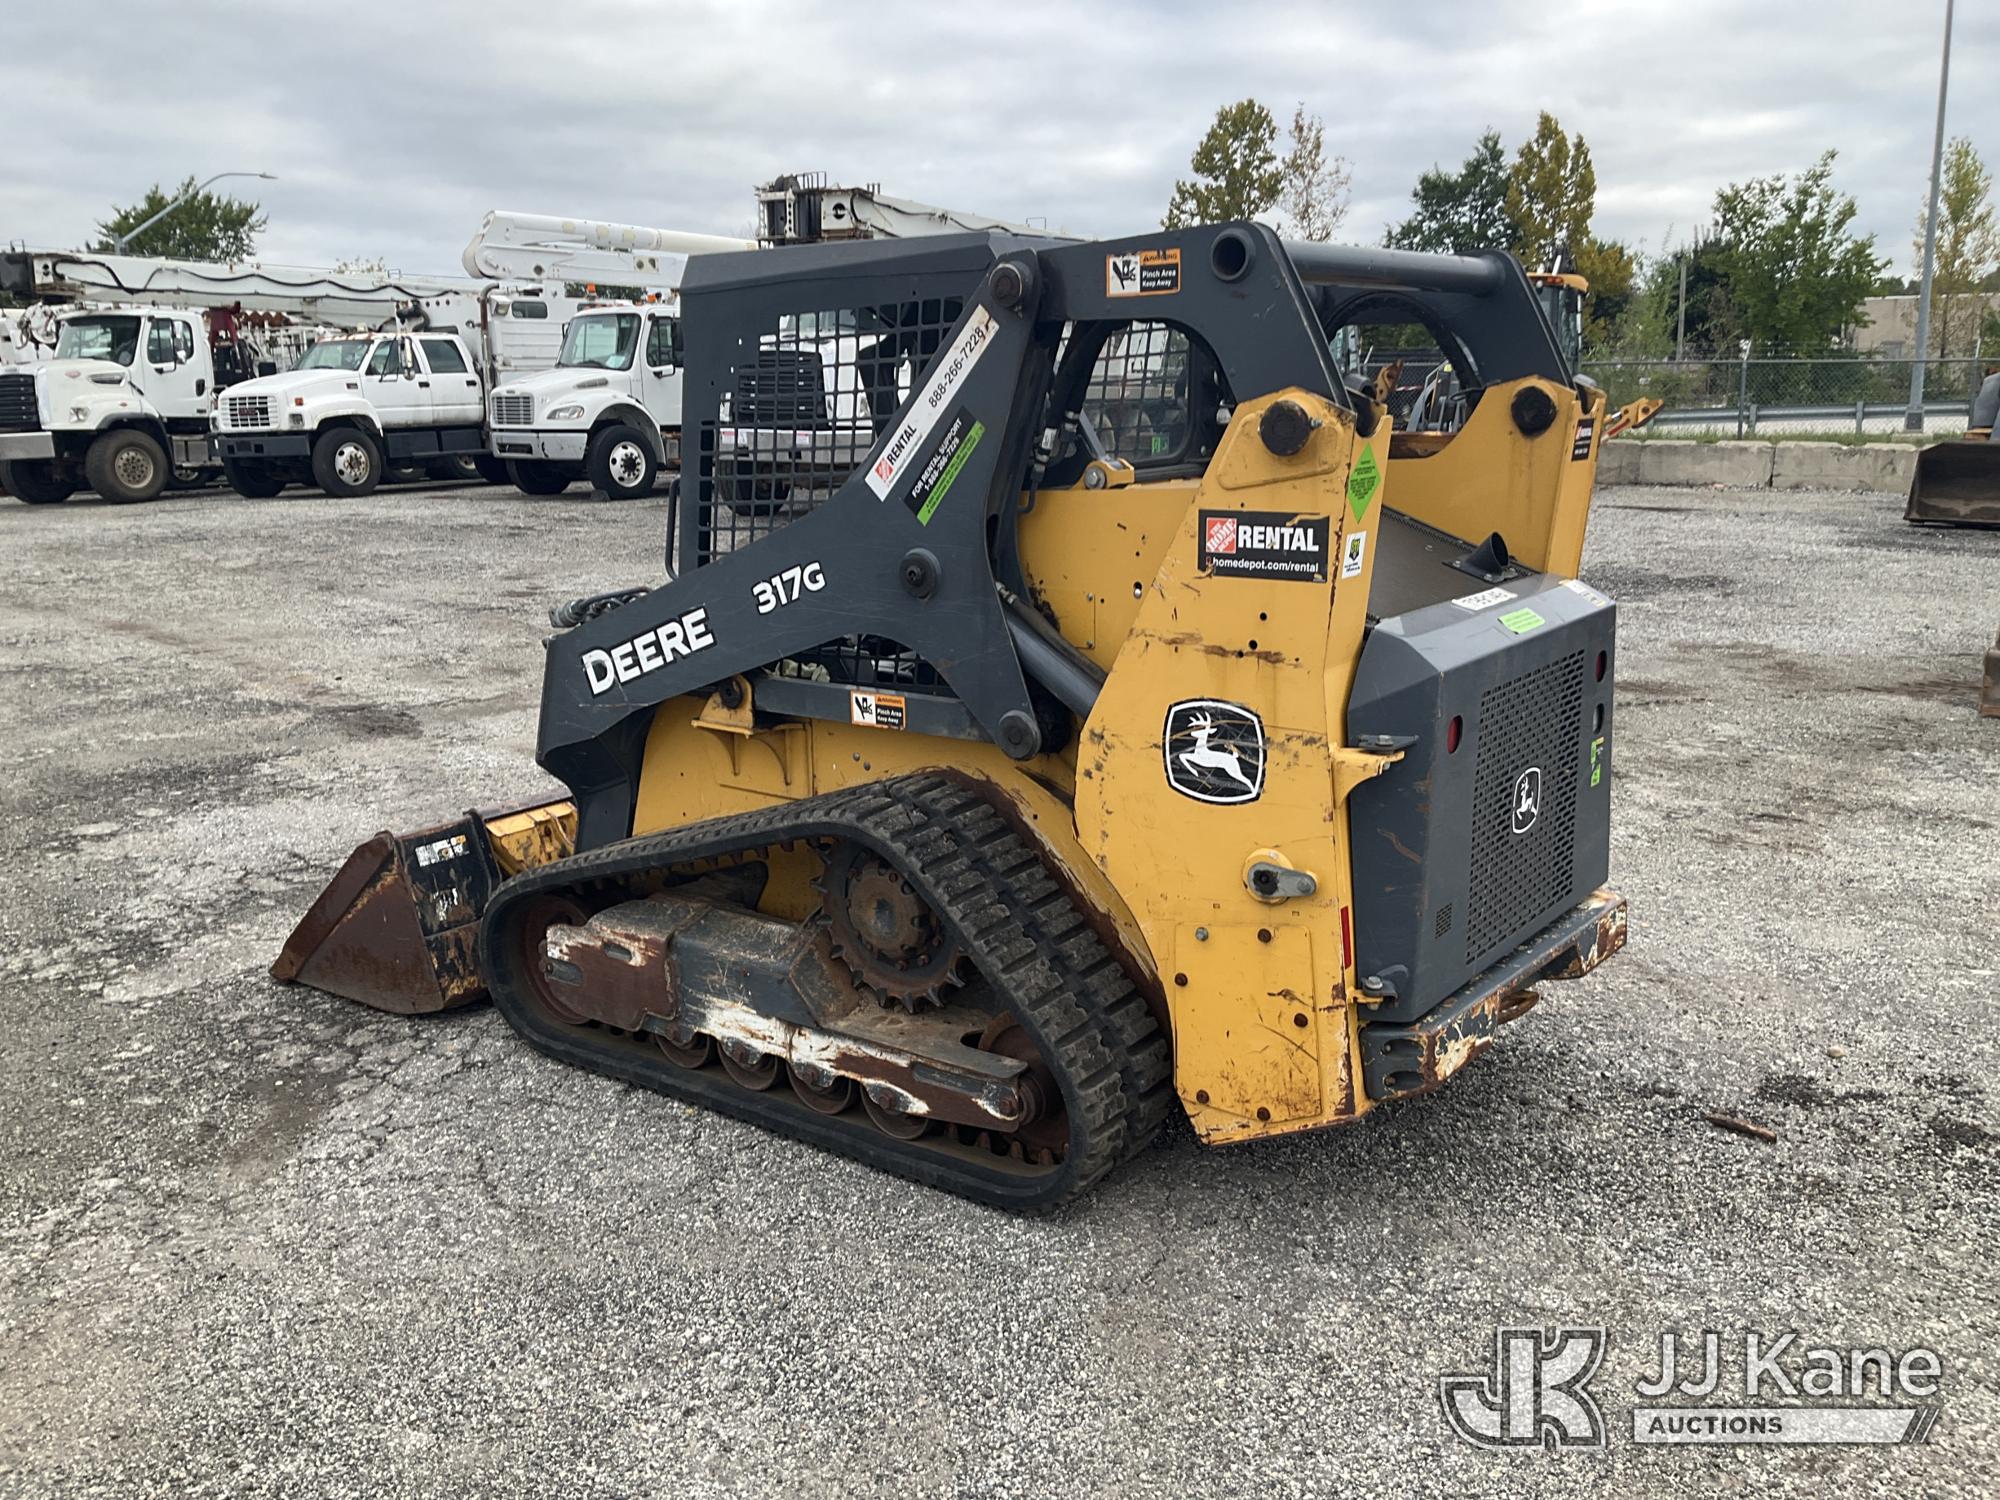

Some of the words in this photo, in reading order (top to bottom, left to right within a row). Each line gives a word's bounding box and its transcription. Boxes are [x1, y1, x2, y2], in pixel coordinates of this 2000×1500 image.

[1142, 269, 1160, 279] Pinch
[1161, 268, 1176, 278] Area
[1142, 279, 1156, 288] Keep
[1156, 278, 1171, 288] Away
[928, 325, 986, 408] 888-266-7228
[886, 423, 917, 465] RENTAL
[911, 479, 925, 498] FOR
[920, 450, 941, 483] RENTAL
[937, 417, 963, 455] SUPPORT
[1237, 525, 1319, 552] RENTAL
[1212, 556, 1319, 573] homedepot.com/rental
[752, 562, 826, 615] 317G
[581, 608, 715, 695] DEERE
